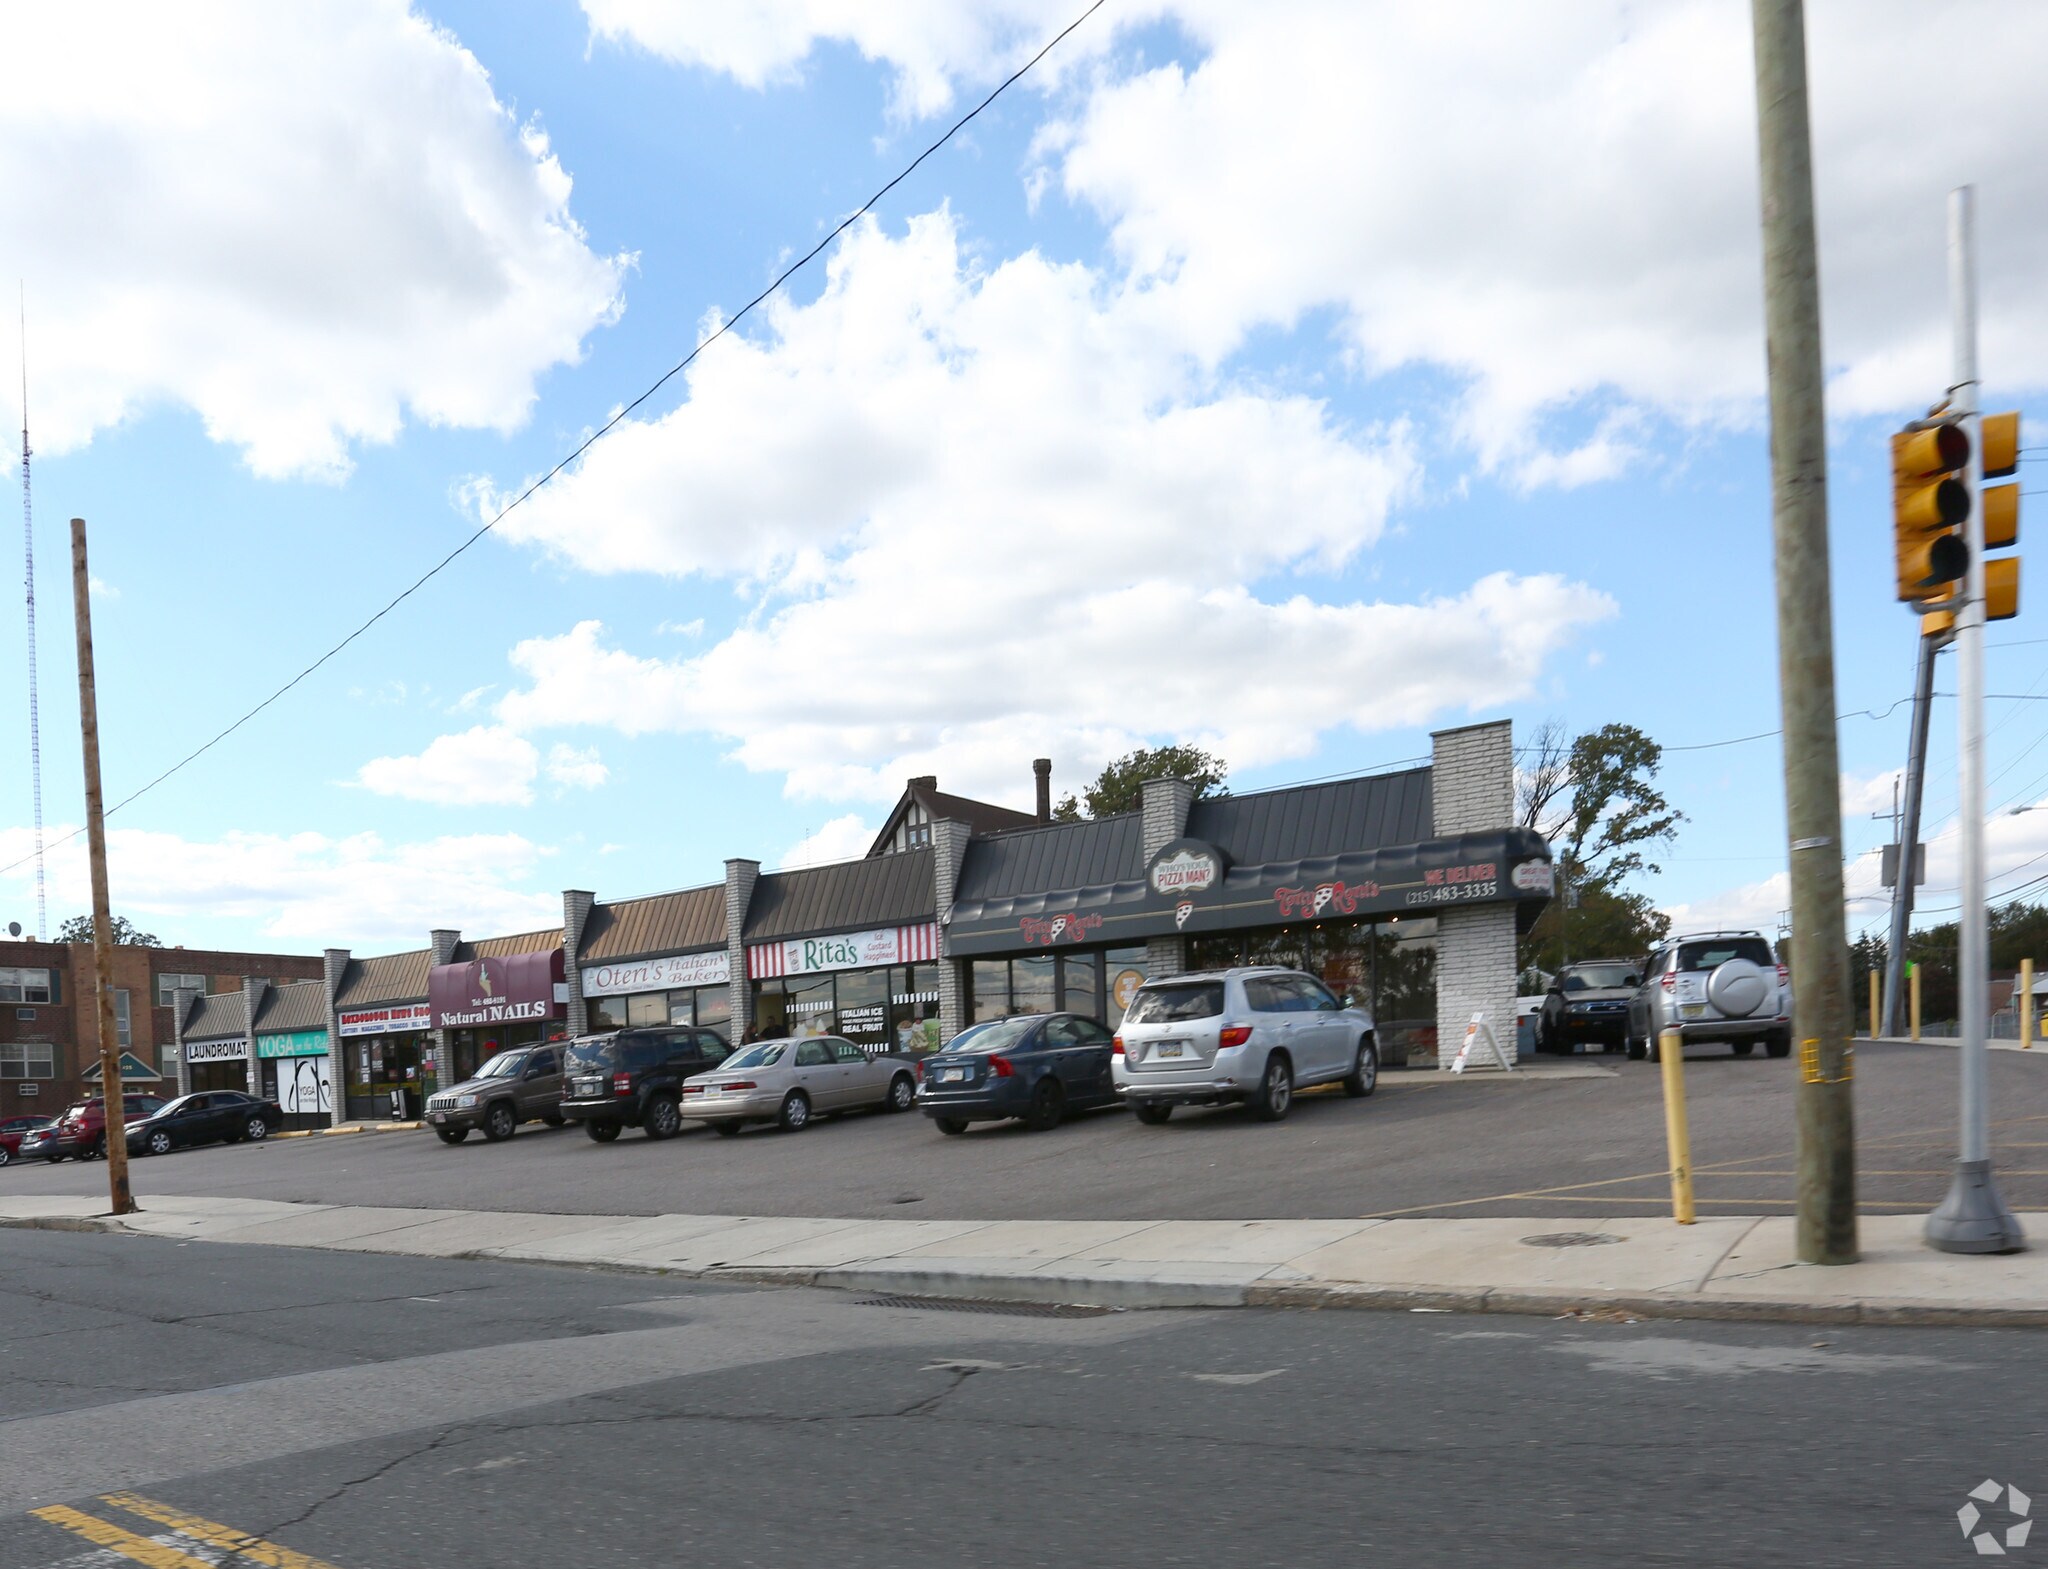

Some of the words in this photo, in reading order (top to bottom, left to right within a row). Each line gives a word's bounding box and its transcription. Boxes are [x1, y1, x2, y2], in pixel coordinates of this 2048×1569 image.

[1158, 871, 1184, 887] PIZZA
[1186, 868, 1210, 883] MAN?
[1424, 869, 1445, 886] WE
[1445, 863, 1497, 884] DELIVER
[804, 938, 857, 970] Rita's
[868, 941, 892, 951] Custard
[668, 954, 718, 972] Italian
[596, 960, 663, 988] Oteri's
[668, 968, 730, 984] Bakery
[440, 1009, 487, 1026] Natural
[489, 1000, 546, 1021] NAILS
[842, 1008, 870, 1019] ITALIAN
[870, 1007, 884, 1016] ICE
[388, 1022, 409, 1030] TOBACCO
[842, 1024, 862, 1033] REAL
[862, 1022, 884, 1032] FRUIT
[188, 1041, 247, 1060] LAUNDROMAT
[258, 1034, 295, 1057] YOGA
[299, 1086, 316, 1096] YOGA
